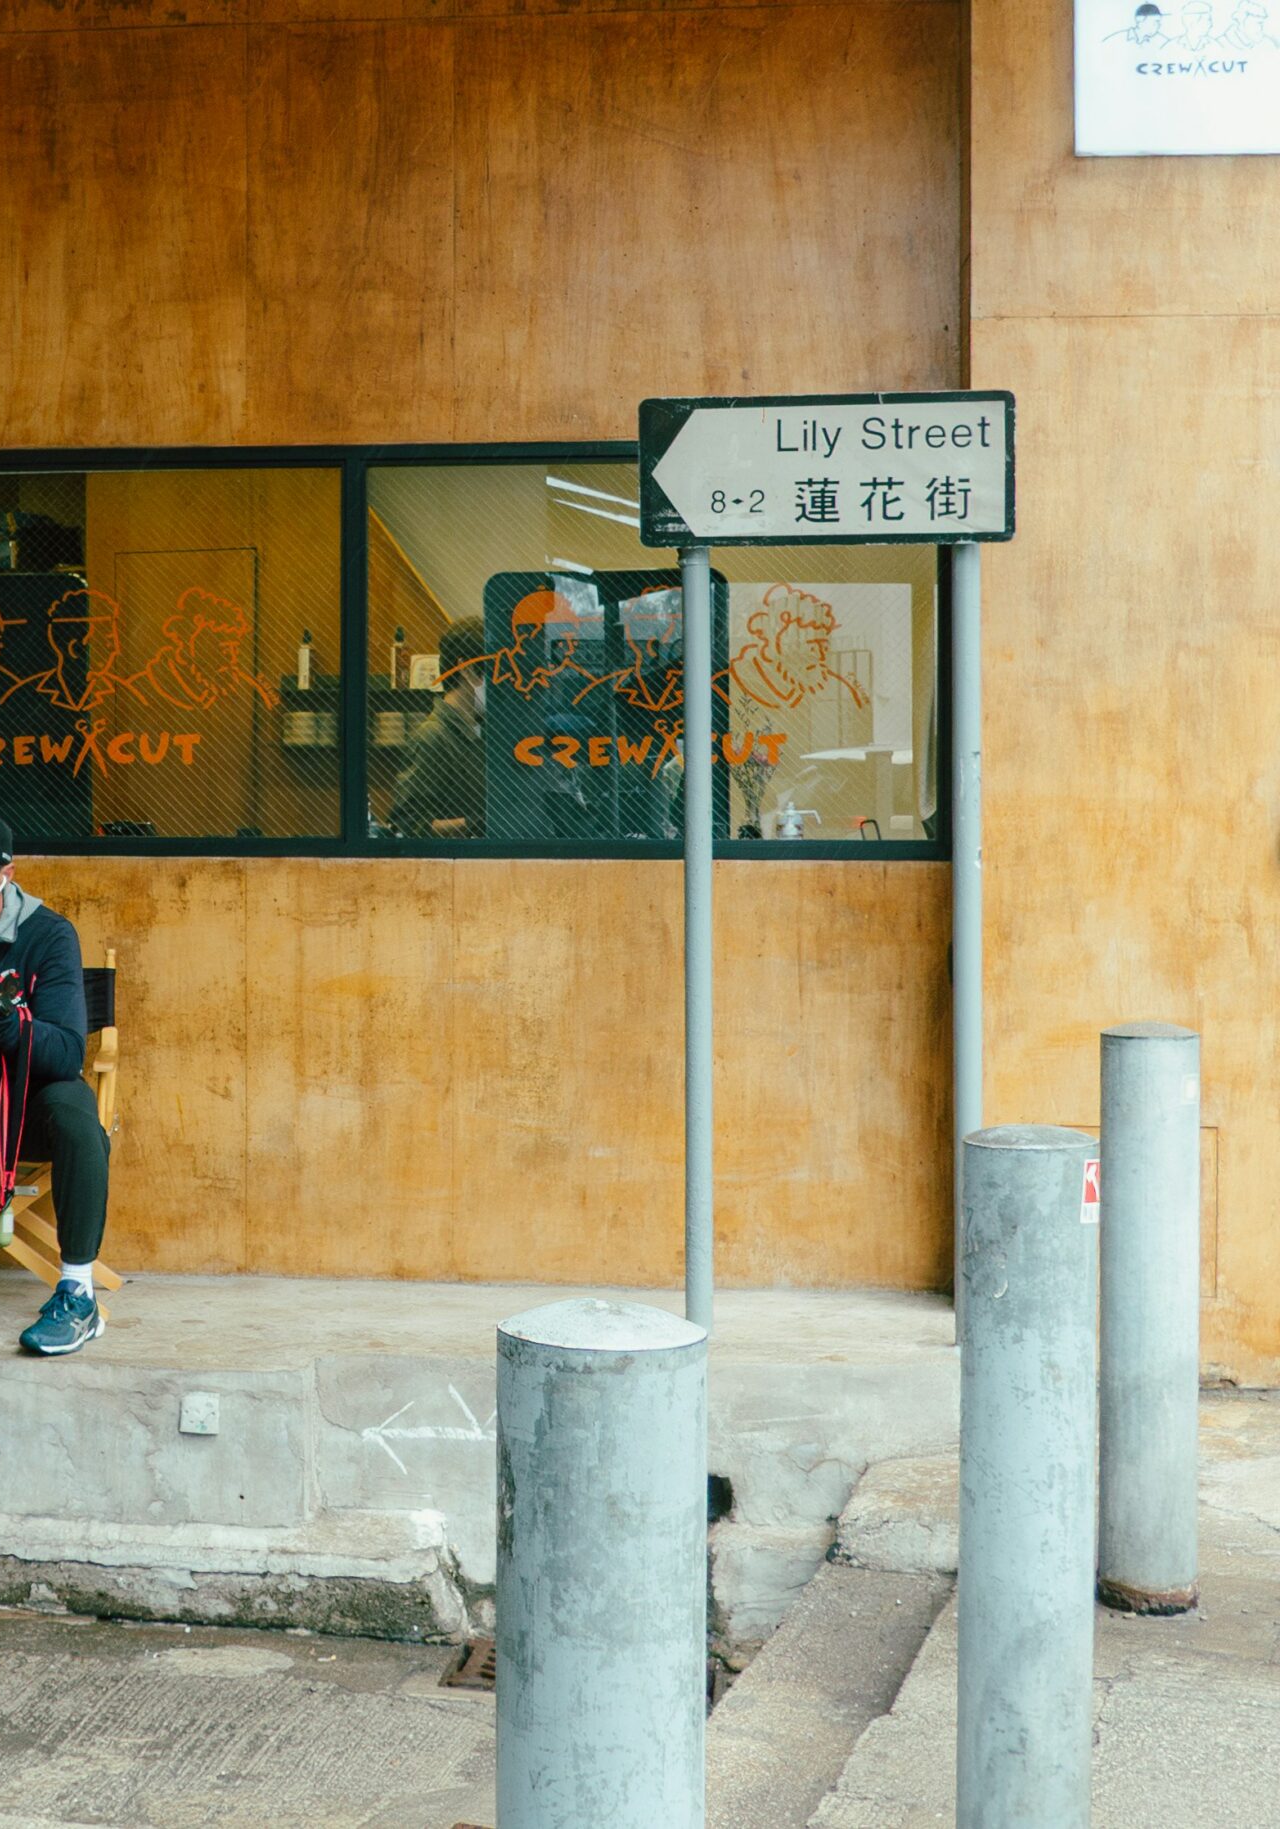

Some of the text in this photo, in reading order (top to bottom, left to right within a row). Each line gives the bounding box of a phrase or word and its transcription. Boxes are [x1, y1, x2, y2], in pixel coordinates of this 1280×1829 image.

[1209, 61, 1248, 73] CUT
[776, 416, 991, 458] Lily Street
[794, 475, 972, 523] 蓮花街
[107, 731, 201, 766] CUT
[514, 731, 788, 768] CREW UT
